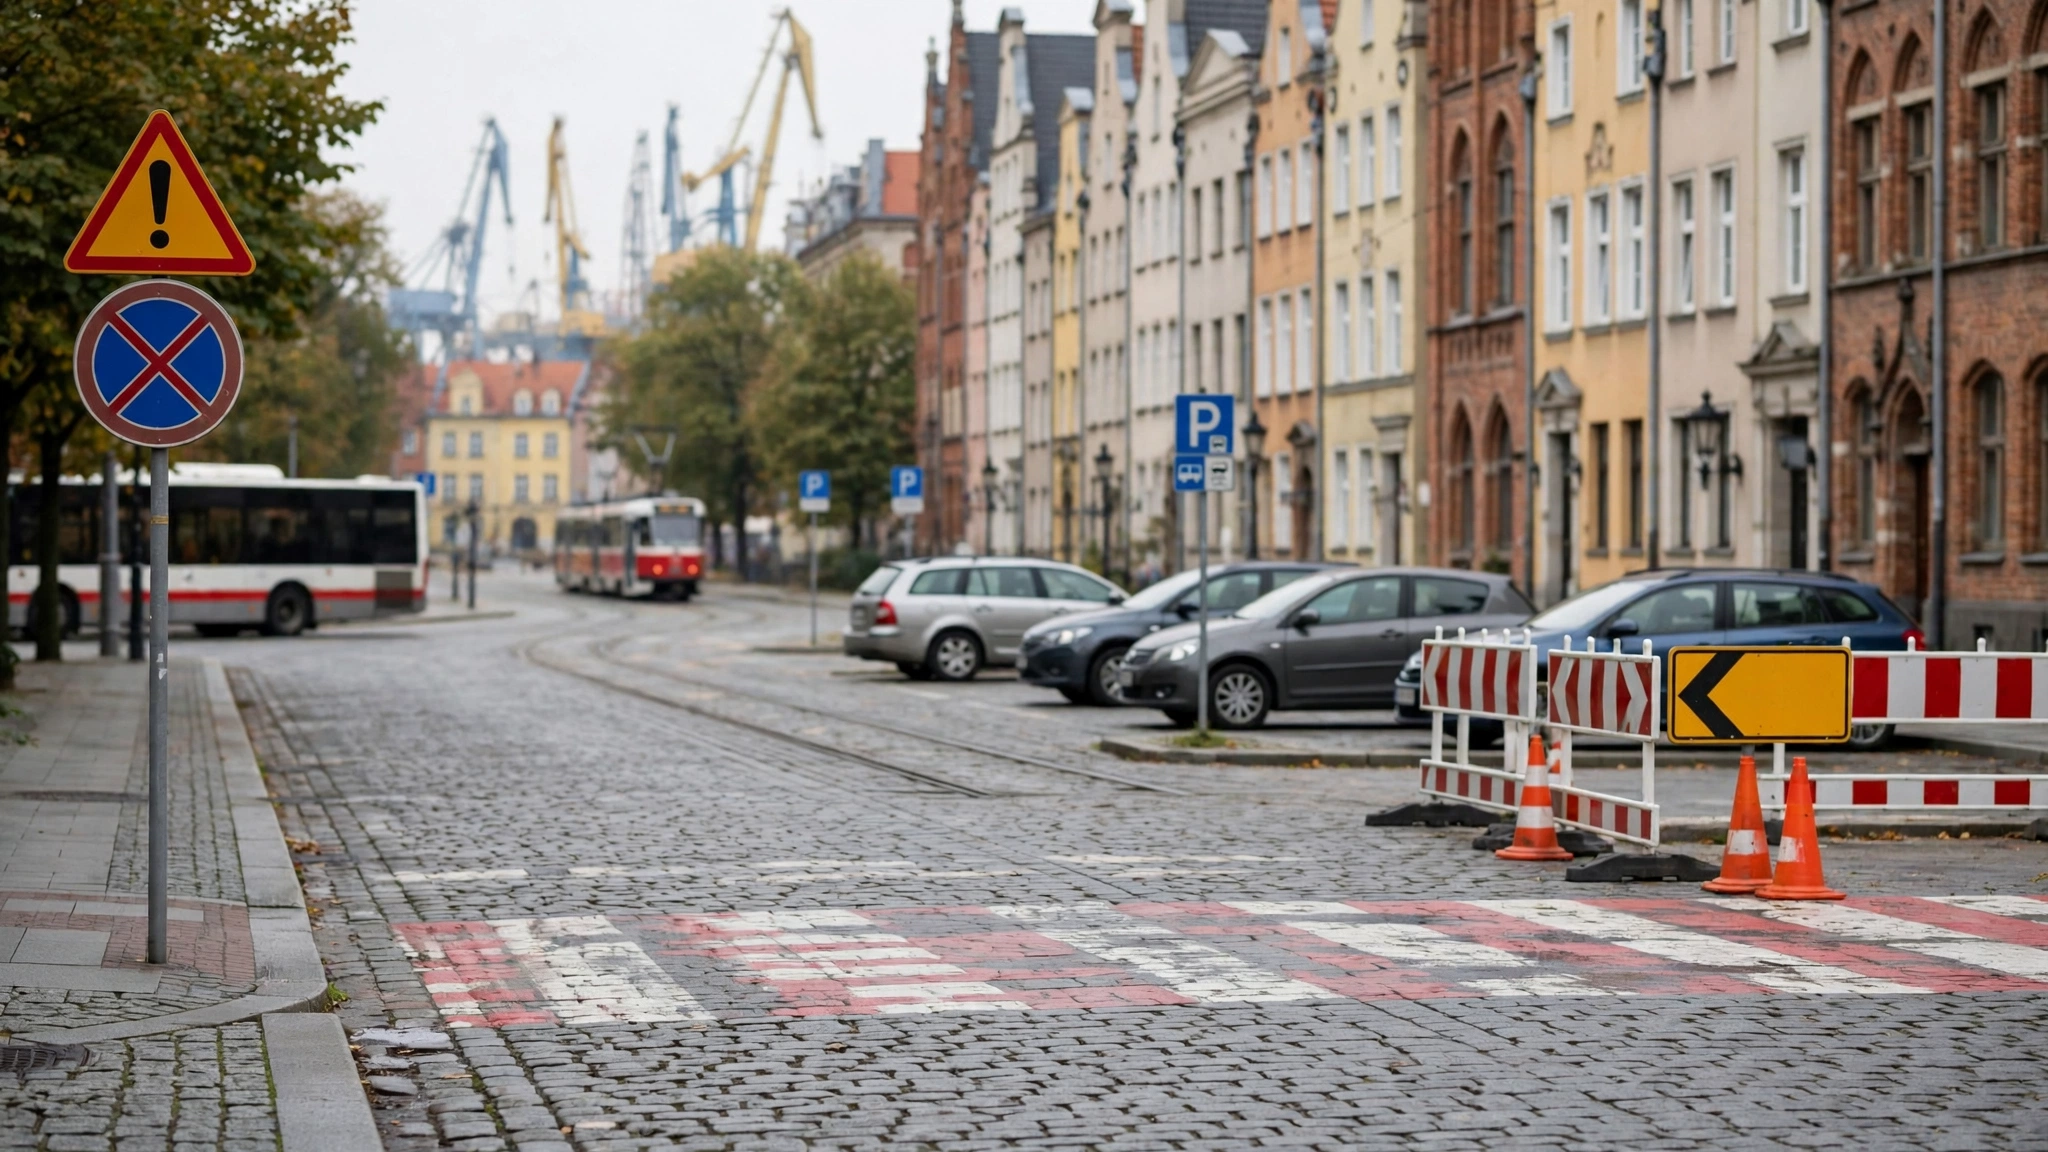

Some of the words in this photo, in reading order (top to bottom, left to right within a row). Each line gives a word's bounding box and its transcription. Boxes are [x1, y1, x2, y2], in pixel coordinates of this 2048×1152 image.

[1189, 401, 1221, 447] P
[806, 472, 823, 496] P
[900, 469, 917, 495] P
